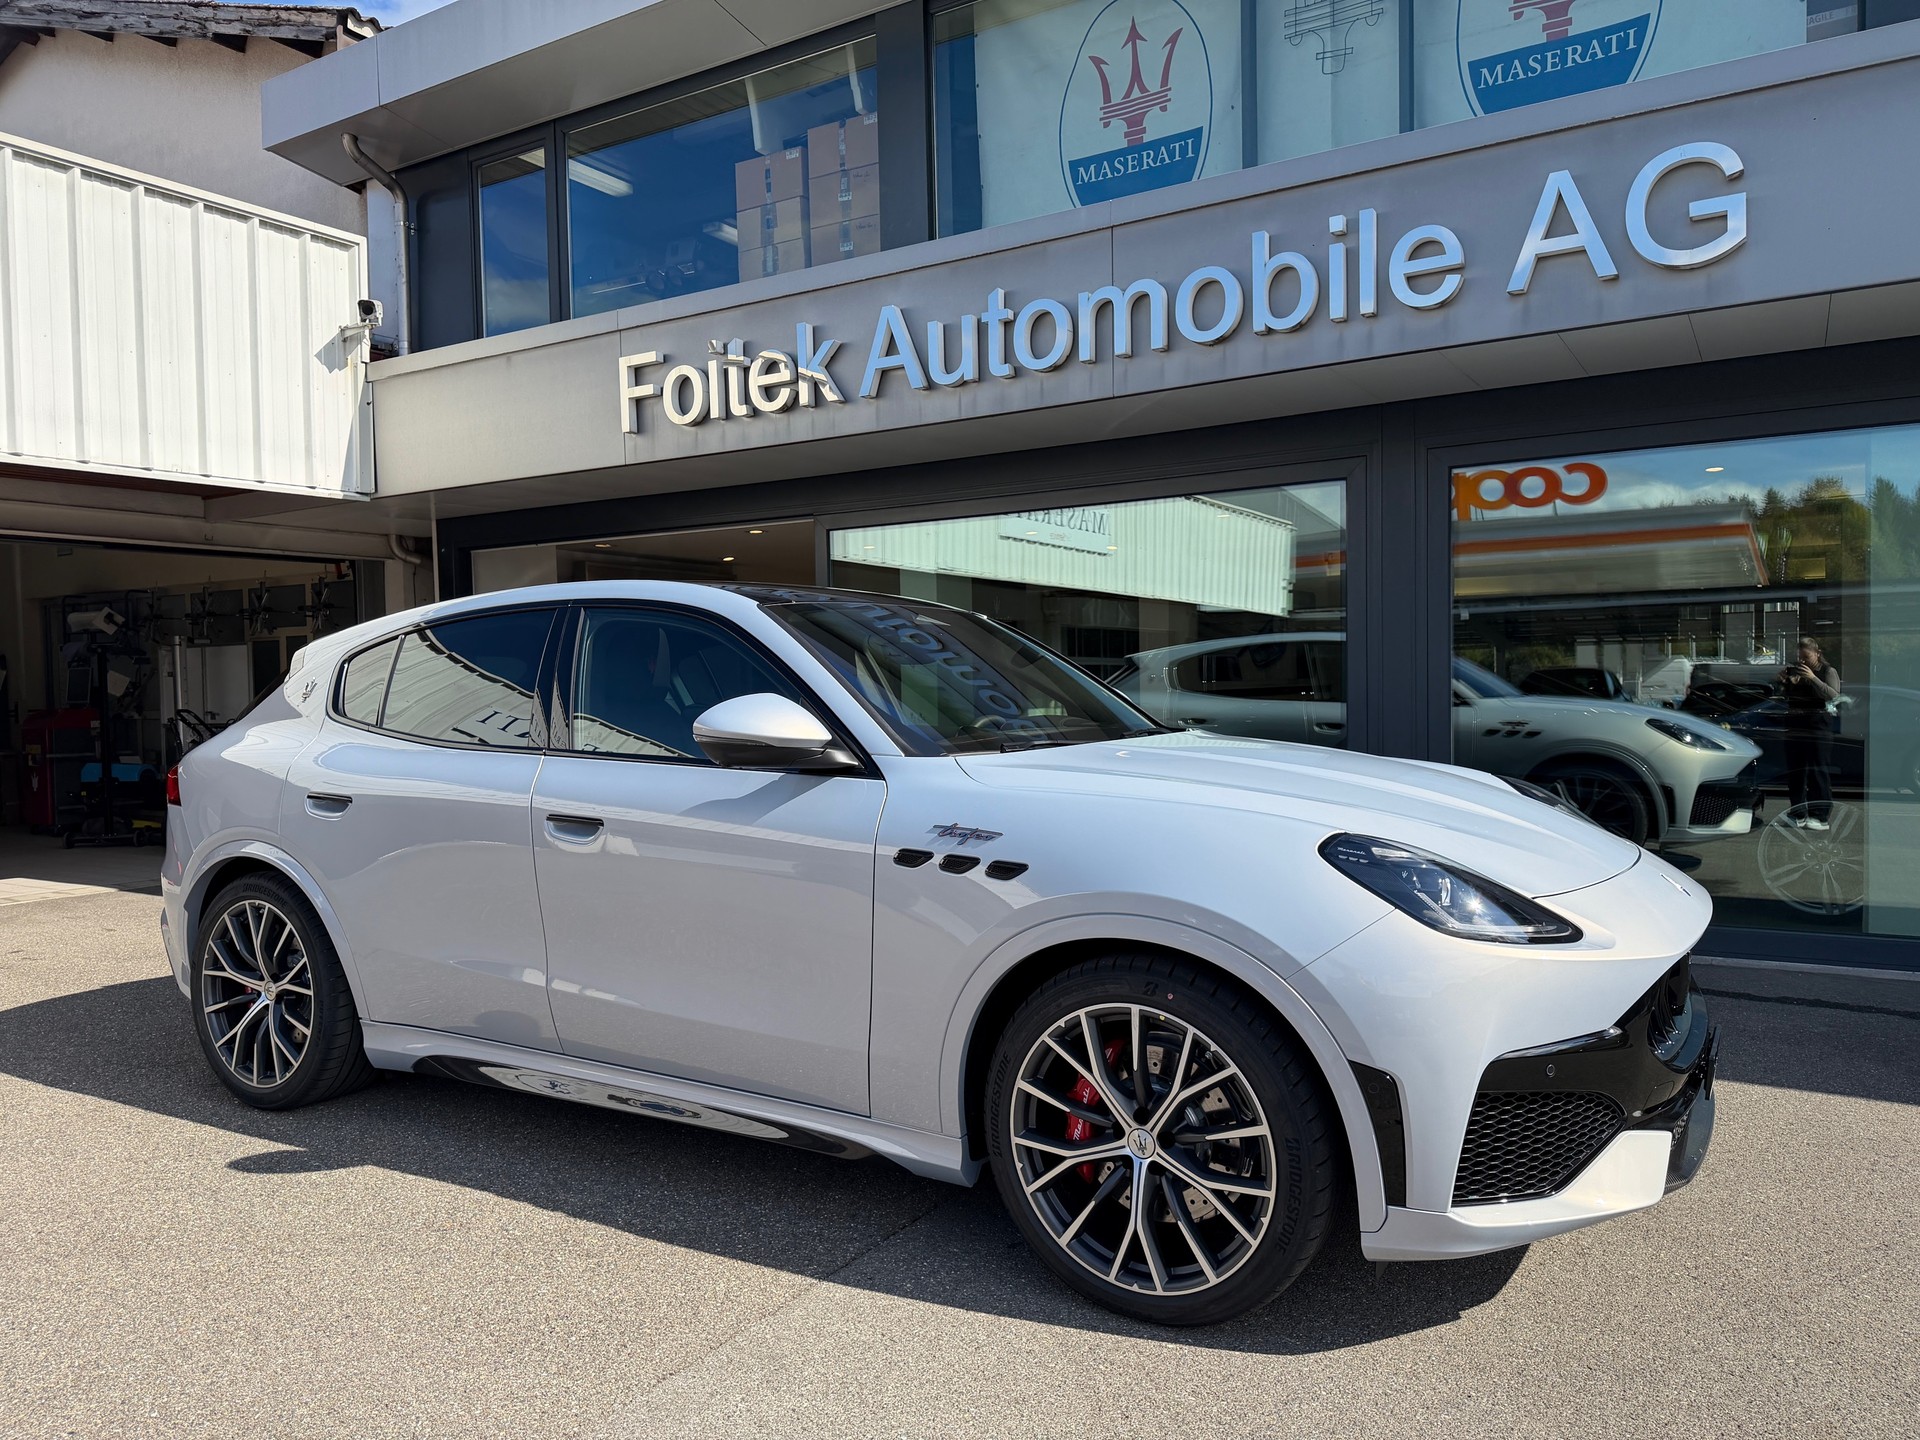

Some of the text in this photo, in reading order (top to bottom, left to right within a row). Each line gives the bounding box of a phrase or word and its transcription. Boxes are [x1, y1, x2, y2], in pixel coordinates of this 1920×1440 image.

[1807, 12, 1833, 25] AGILE
[1477, 27, 1638, 89] MASERATI
[1076, 138, 1195, 185] MASERATI
[618, 141, 1748, 434] Foitek Automobile AG
